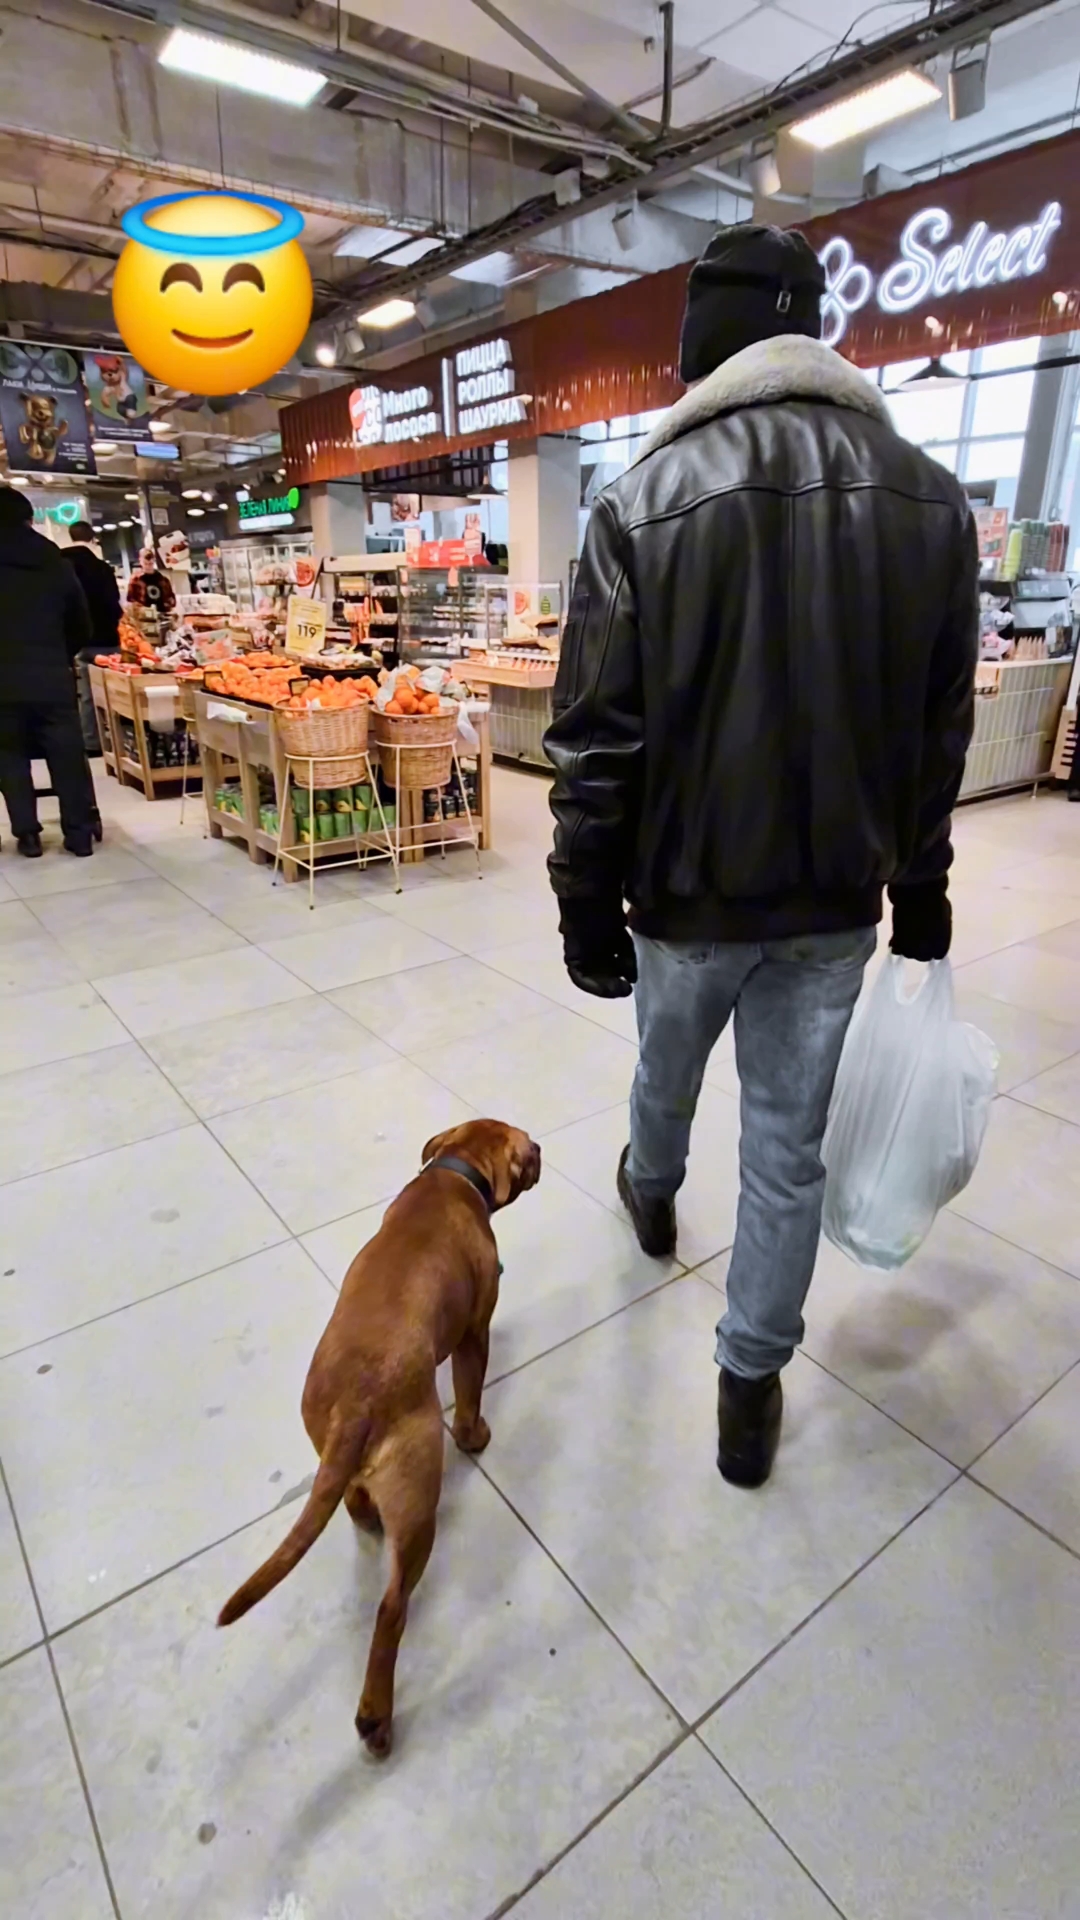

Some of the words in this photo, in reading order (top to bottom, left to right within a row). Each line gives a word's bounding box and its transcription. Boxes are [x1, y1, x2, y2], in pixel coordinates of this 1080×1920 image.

[877, 201, 1062, 314] Select
[456, 338, 508, 377] ПИЦЦА
[382, 386, 429, 417] Много
[457, 368, 510, 406] РОЛЛЫ
[458, 397, 522, 435] ШАУРМА
[297, 624, 317, 639] 119
